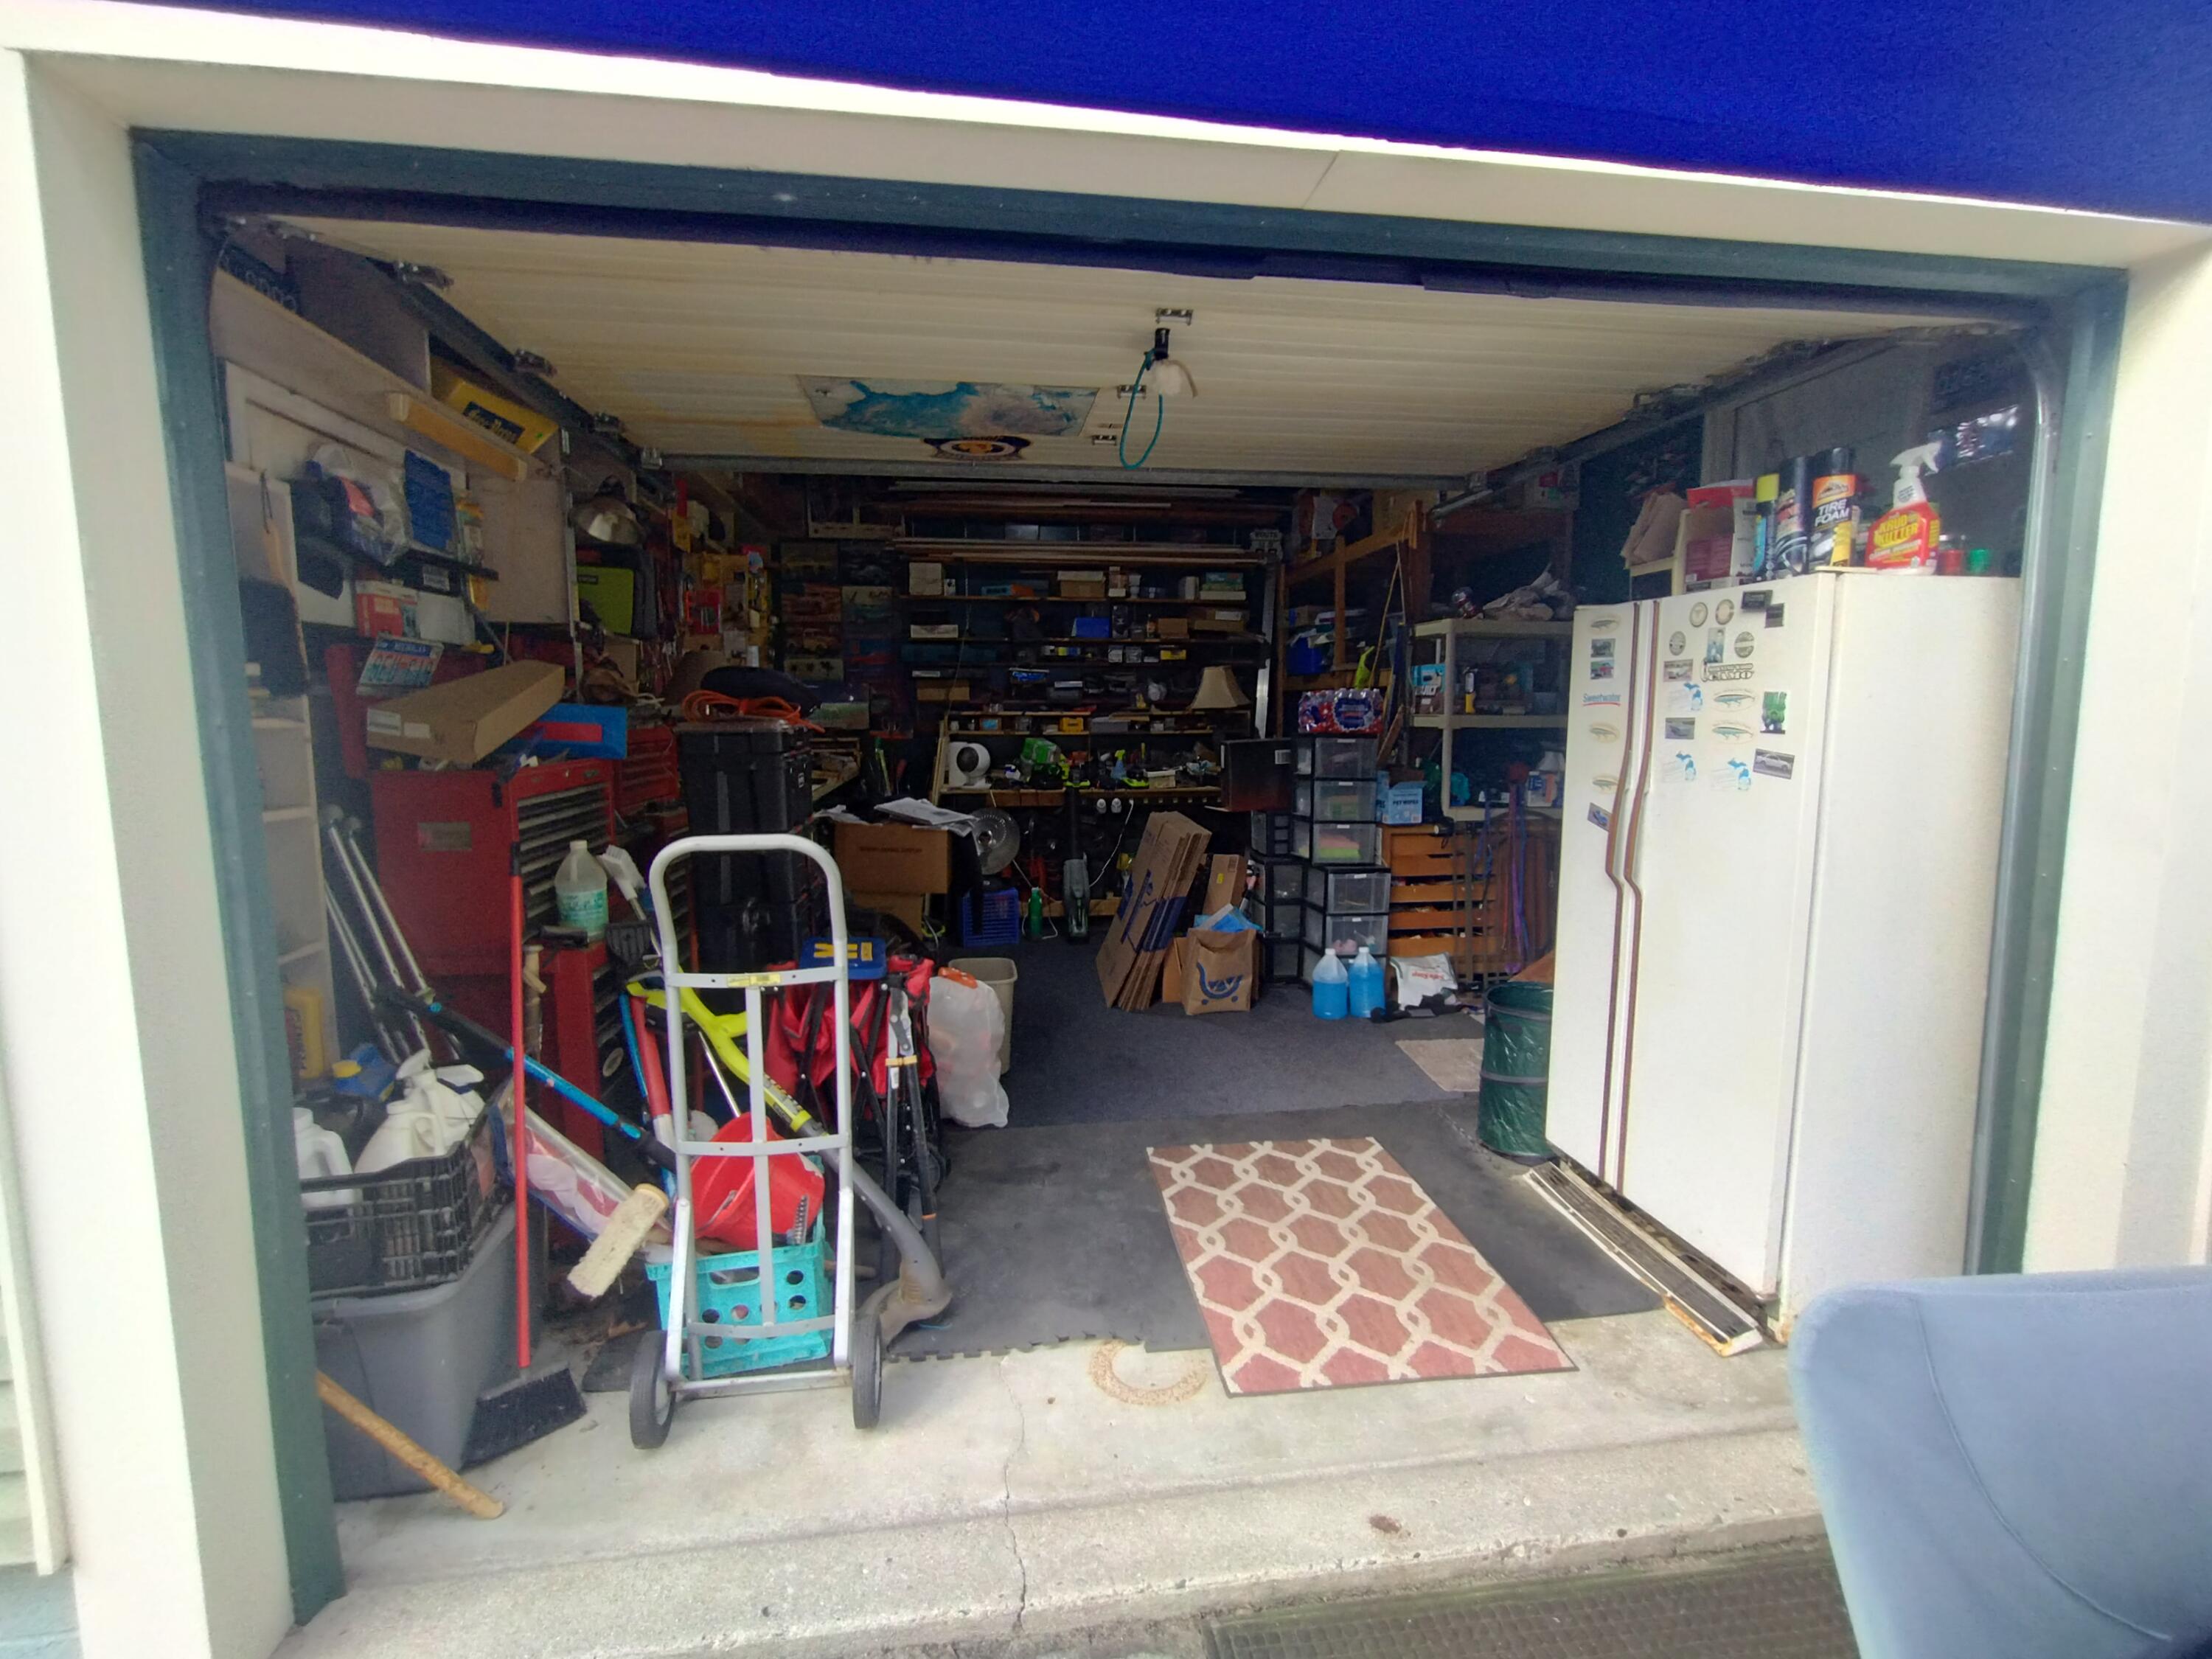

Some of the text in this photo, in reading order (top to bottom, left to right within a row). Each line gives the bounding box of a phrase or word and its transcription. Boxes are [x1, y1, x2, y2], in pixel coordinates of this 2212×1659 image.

[1818, 499, 1847, 515] TIRE
[1815, 508, 1850, 527] FOAM
[1879, 515, 1907, 532] KRUD
[1582, 693, 1621, 703] Sweetwater
